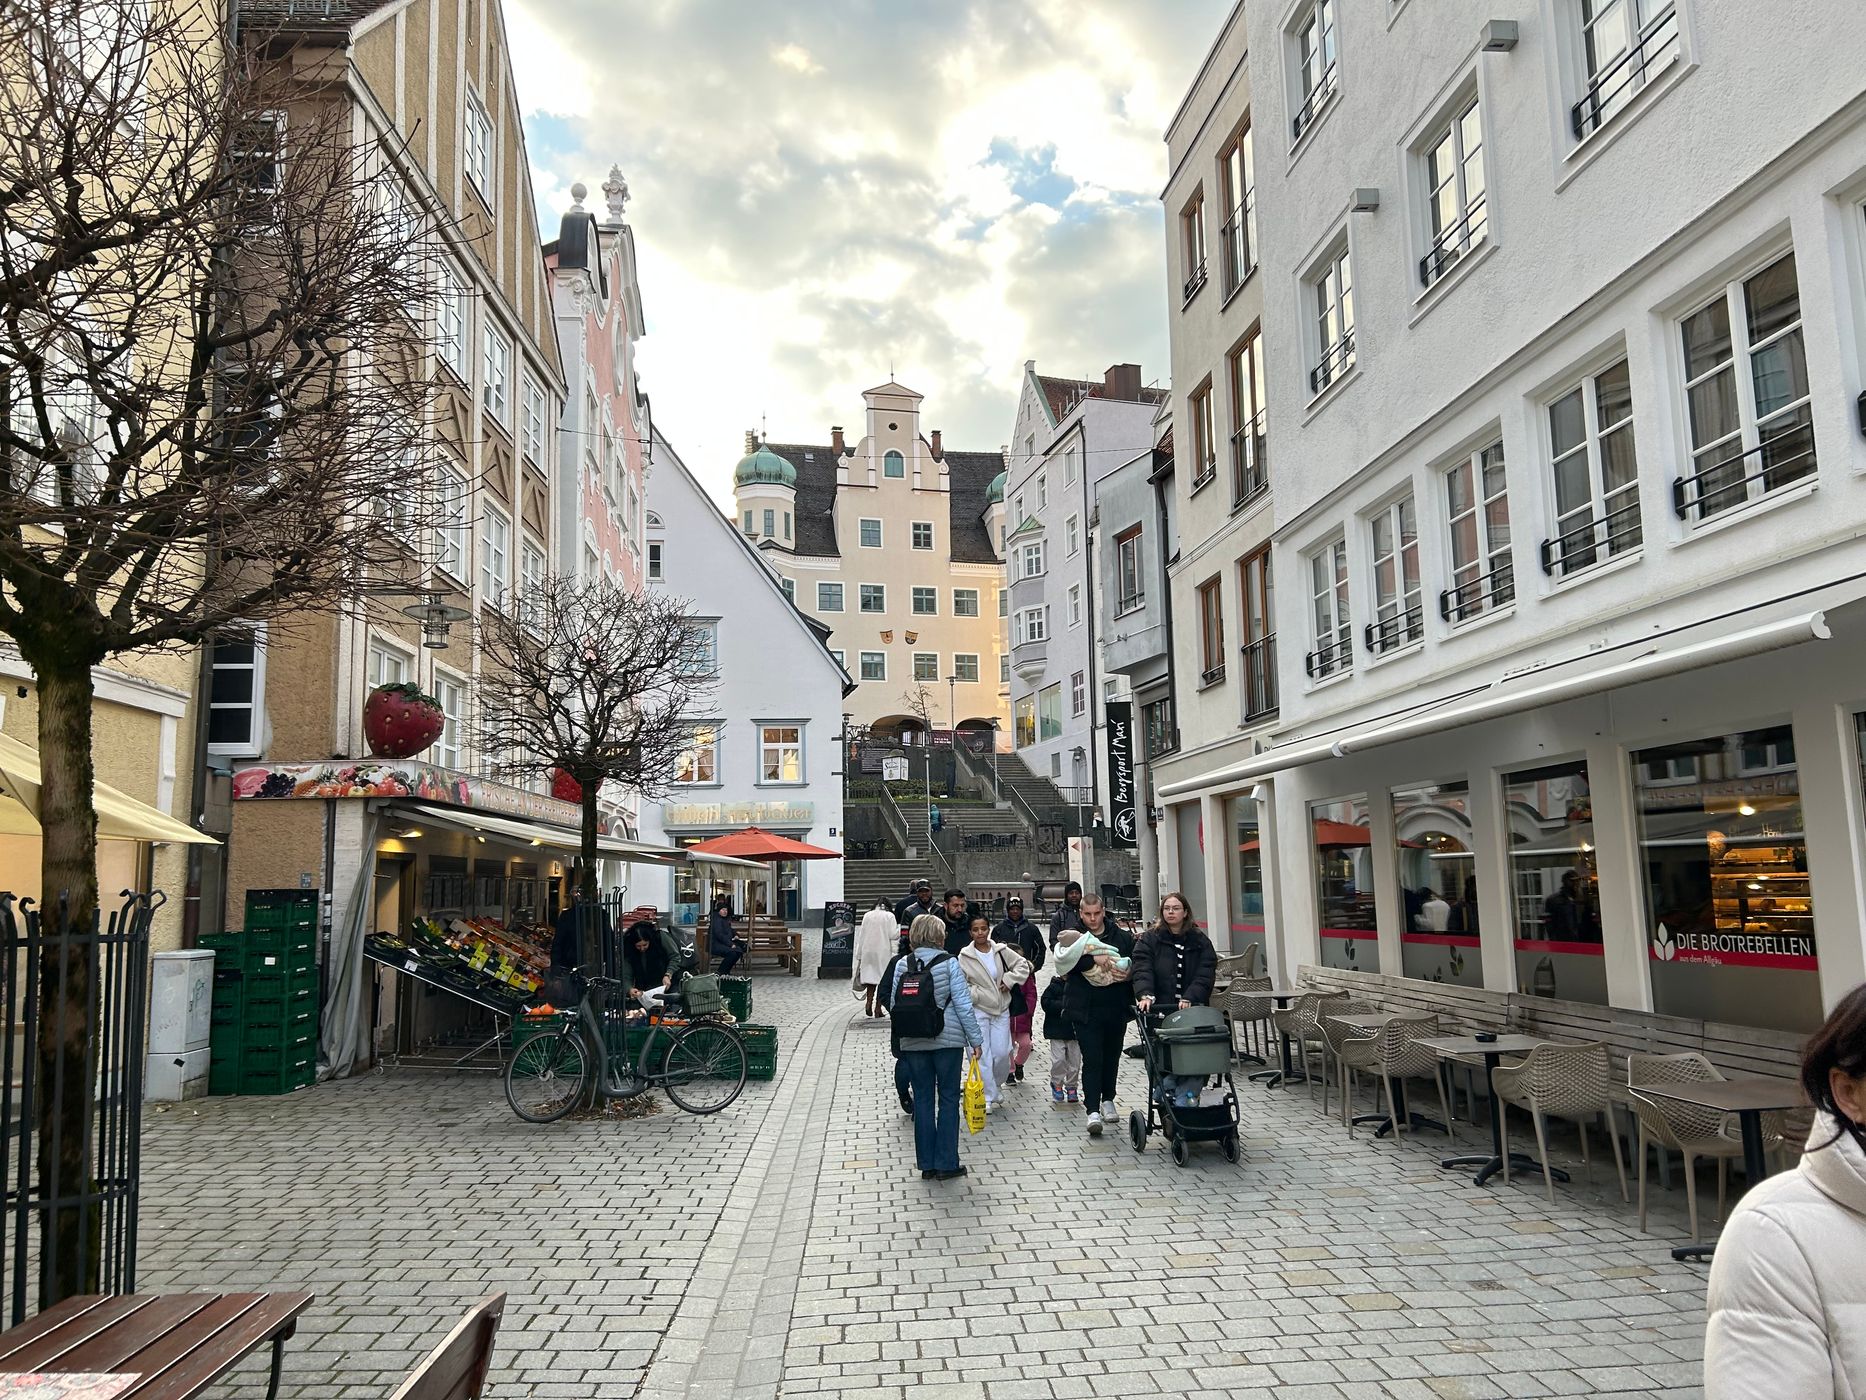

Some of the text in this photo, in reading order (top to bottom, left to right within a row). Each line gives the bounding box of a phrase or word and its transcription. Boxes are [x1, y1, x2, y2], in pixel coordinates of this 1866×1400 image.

[1110, 749, 1132, 803] Bergsport
[481, 782, 515, 813] FRISCHE
[1677, 933, 1811, 956] DIE BROTREBELLEN
[1690, 954, 1702, 963] dem
[1703, 955, 1722, 967] Allgäu
